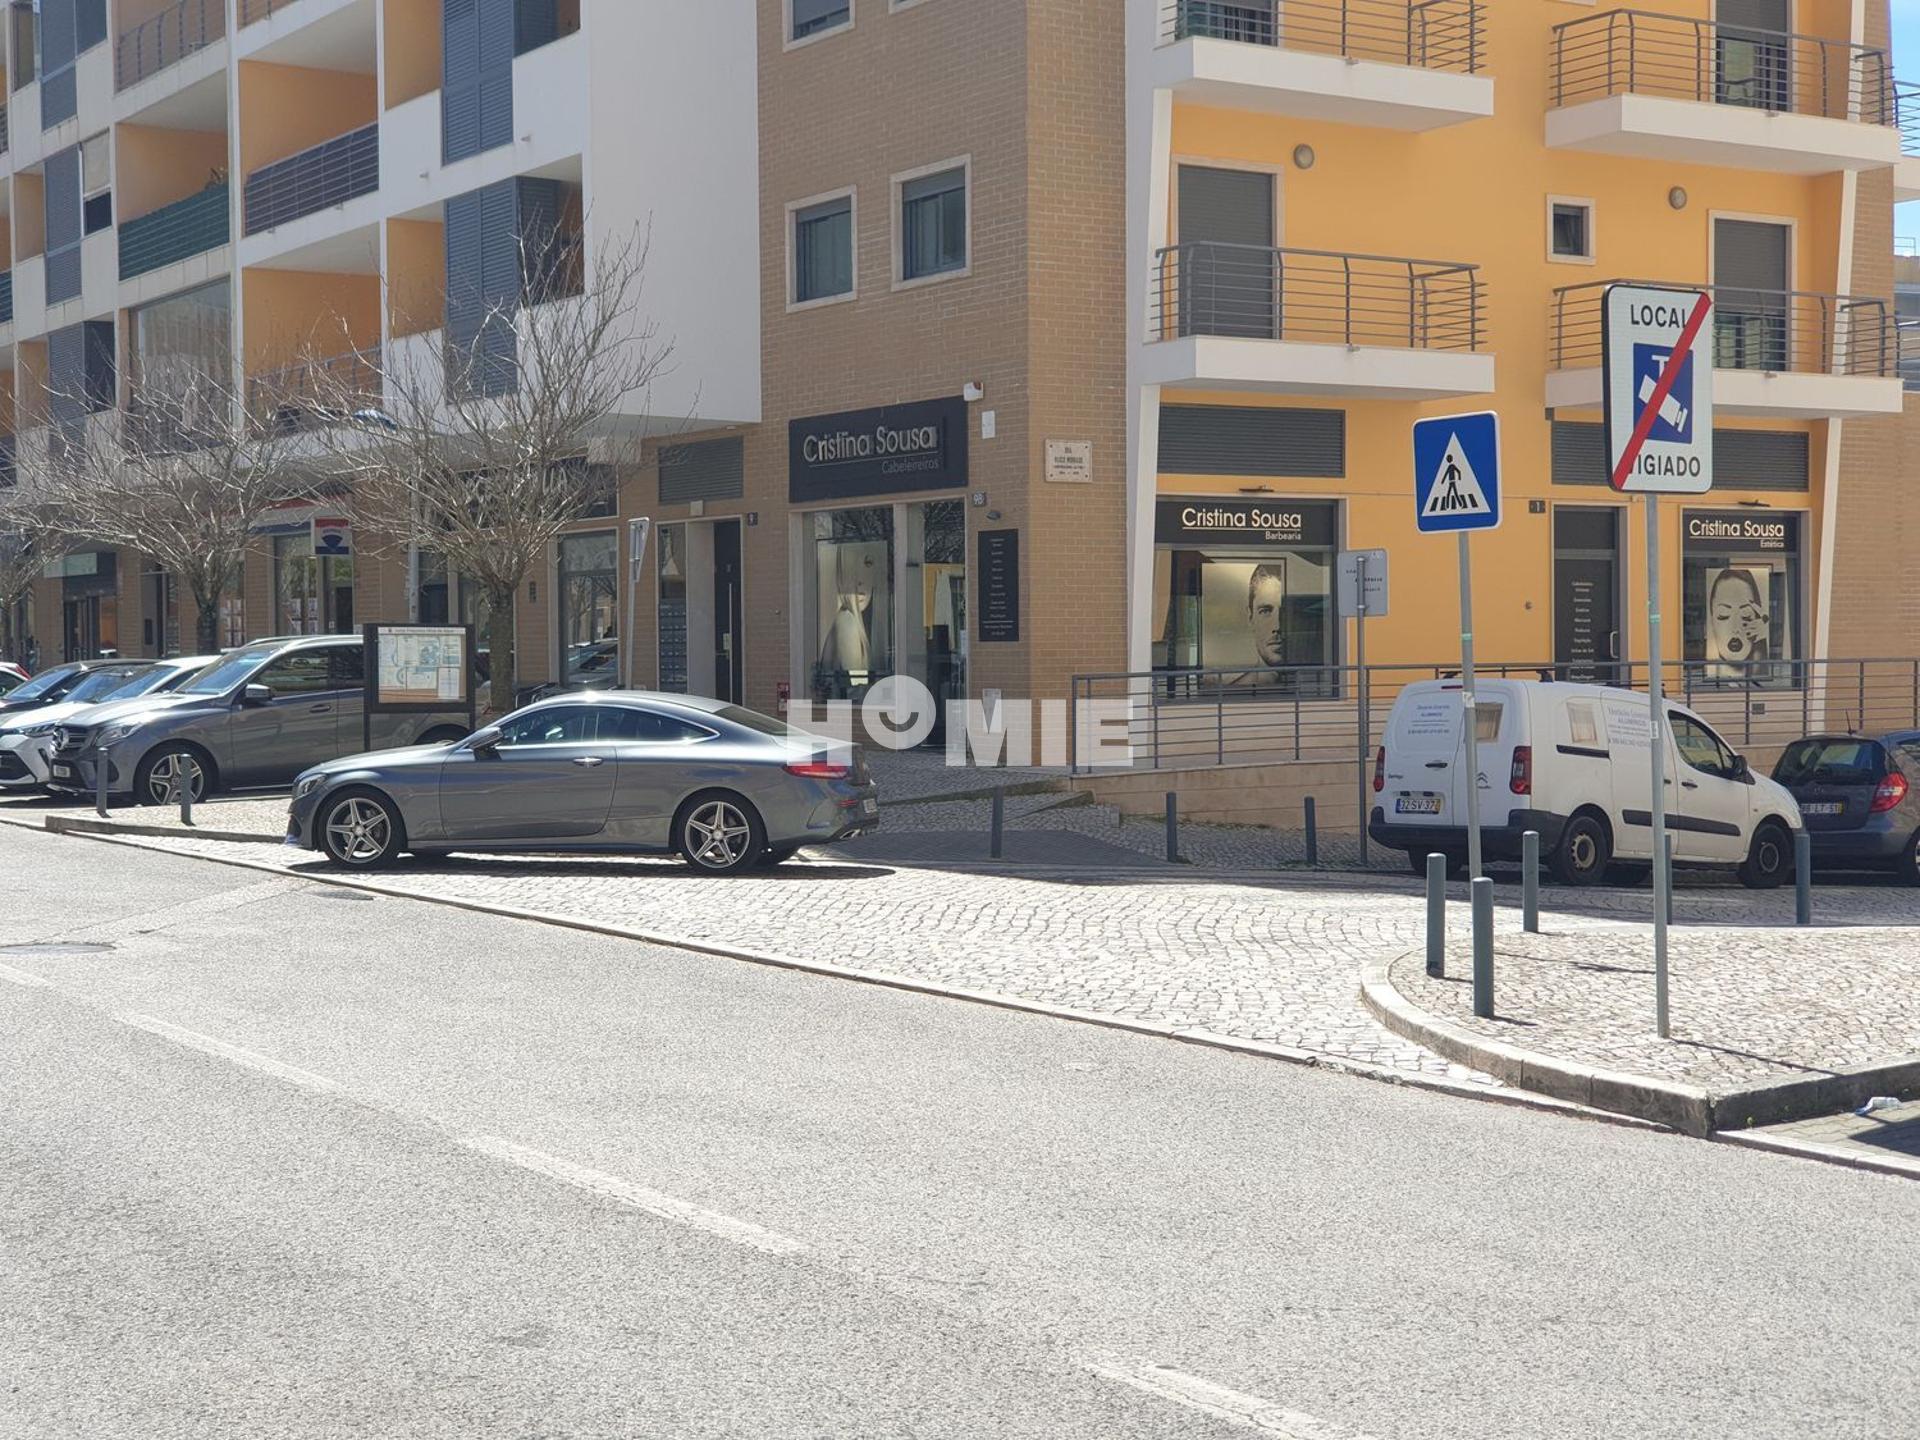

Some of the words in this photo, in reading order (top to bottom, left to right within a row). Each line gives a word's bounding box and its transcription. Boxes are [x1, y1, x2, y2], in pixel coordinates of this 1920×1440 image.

[1630, 303, 1686, 329] LOCAL
[803, 431, 871, 462] Cristina
[876, 426, 937, 454] Sousa
[1628, 453, 1701, 477] IGIADO
[1182, 507, 1246, 527] Cristina
[1251, 508, 1301, 528] Sousa
[1689, 519, 1740, 536] Cristina
[1744, 520, 1784, 537] Sousa
[1265, 530, 1301, 541] Barbearia
